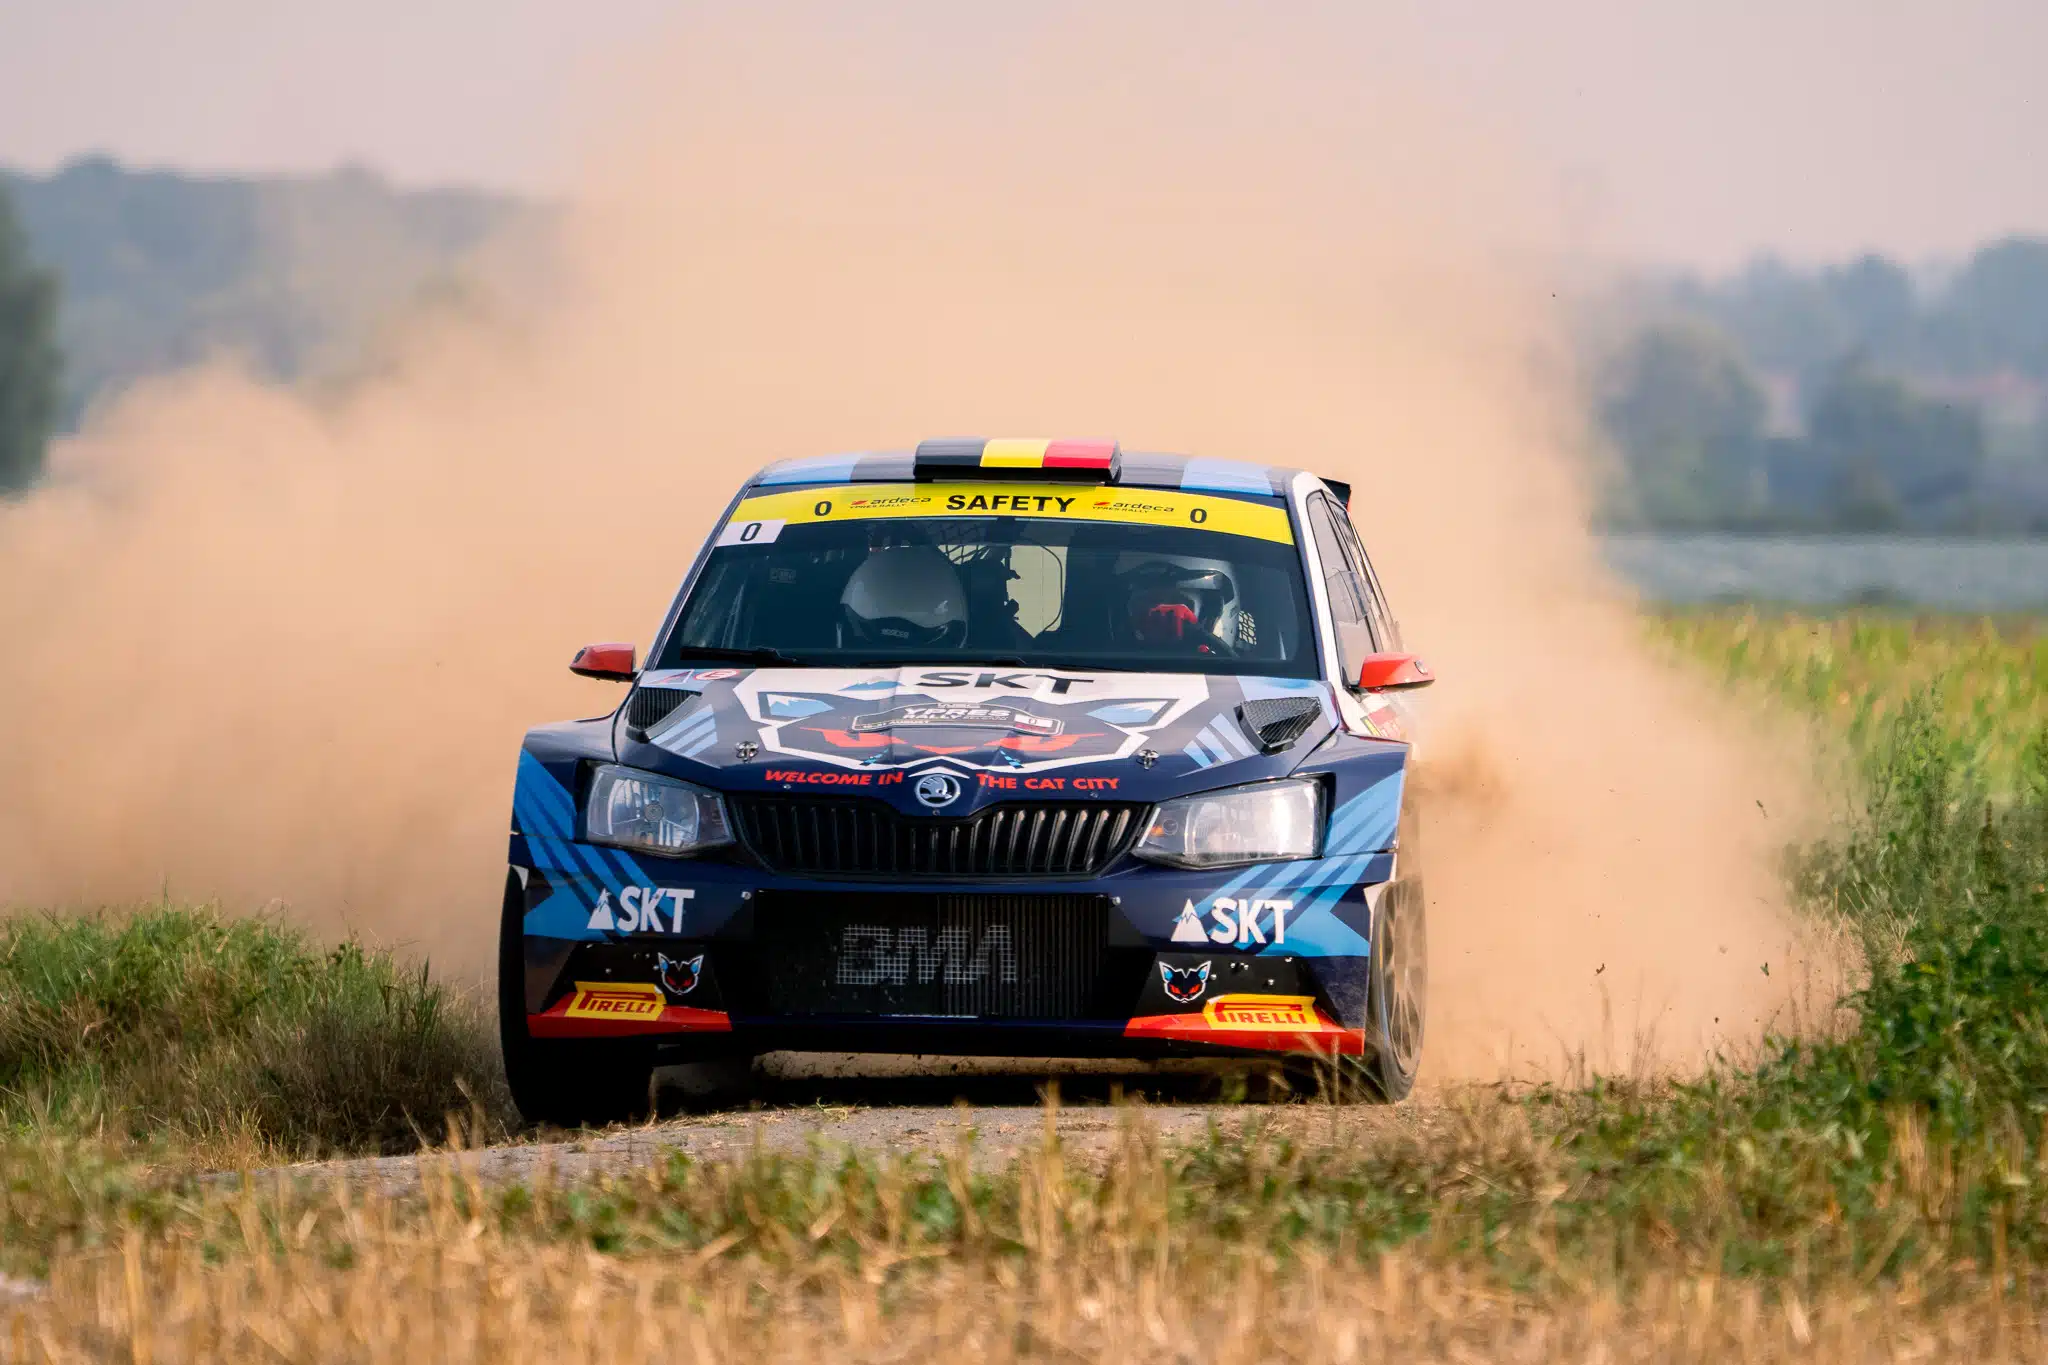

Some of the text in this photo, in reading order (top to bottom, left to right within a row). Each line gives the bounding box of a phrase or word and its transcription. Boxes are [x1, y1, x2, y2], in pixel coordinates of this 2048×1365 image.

[814, 501, 832, 516] 0
[870, 496, 932, 505] ardeca
[945, 494, 1076, 512] SAFETY
[1113, 502, 1175, 512] ardeca
[1190, 508, 1208, 523] 0
[740, 523, 762, 542] 0
[915, 672, 1095, 695] SKT
[903, 708, 1010, 717] YPRES
[765, 769, 904, 785] WELCOME IN
[976, 773, 1120, 790] THE CAT CITY
[617, 885, 695, 933] SKT
[1210, 897, 1293, 944] SKT
[575, 989, 656, 1014] PIRELLI
[1213, 1002, 1308, 1025] PIRELLI
